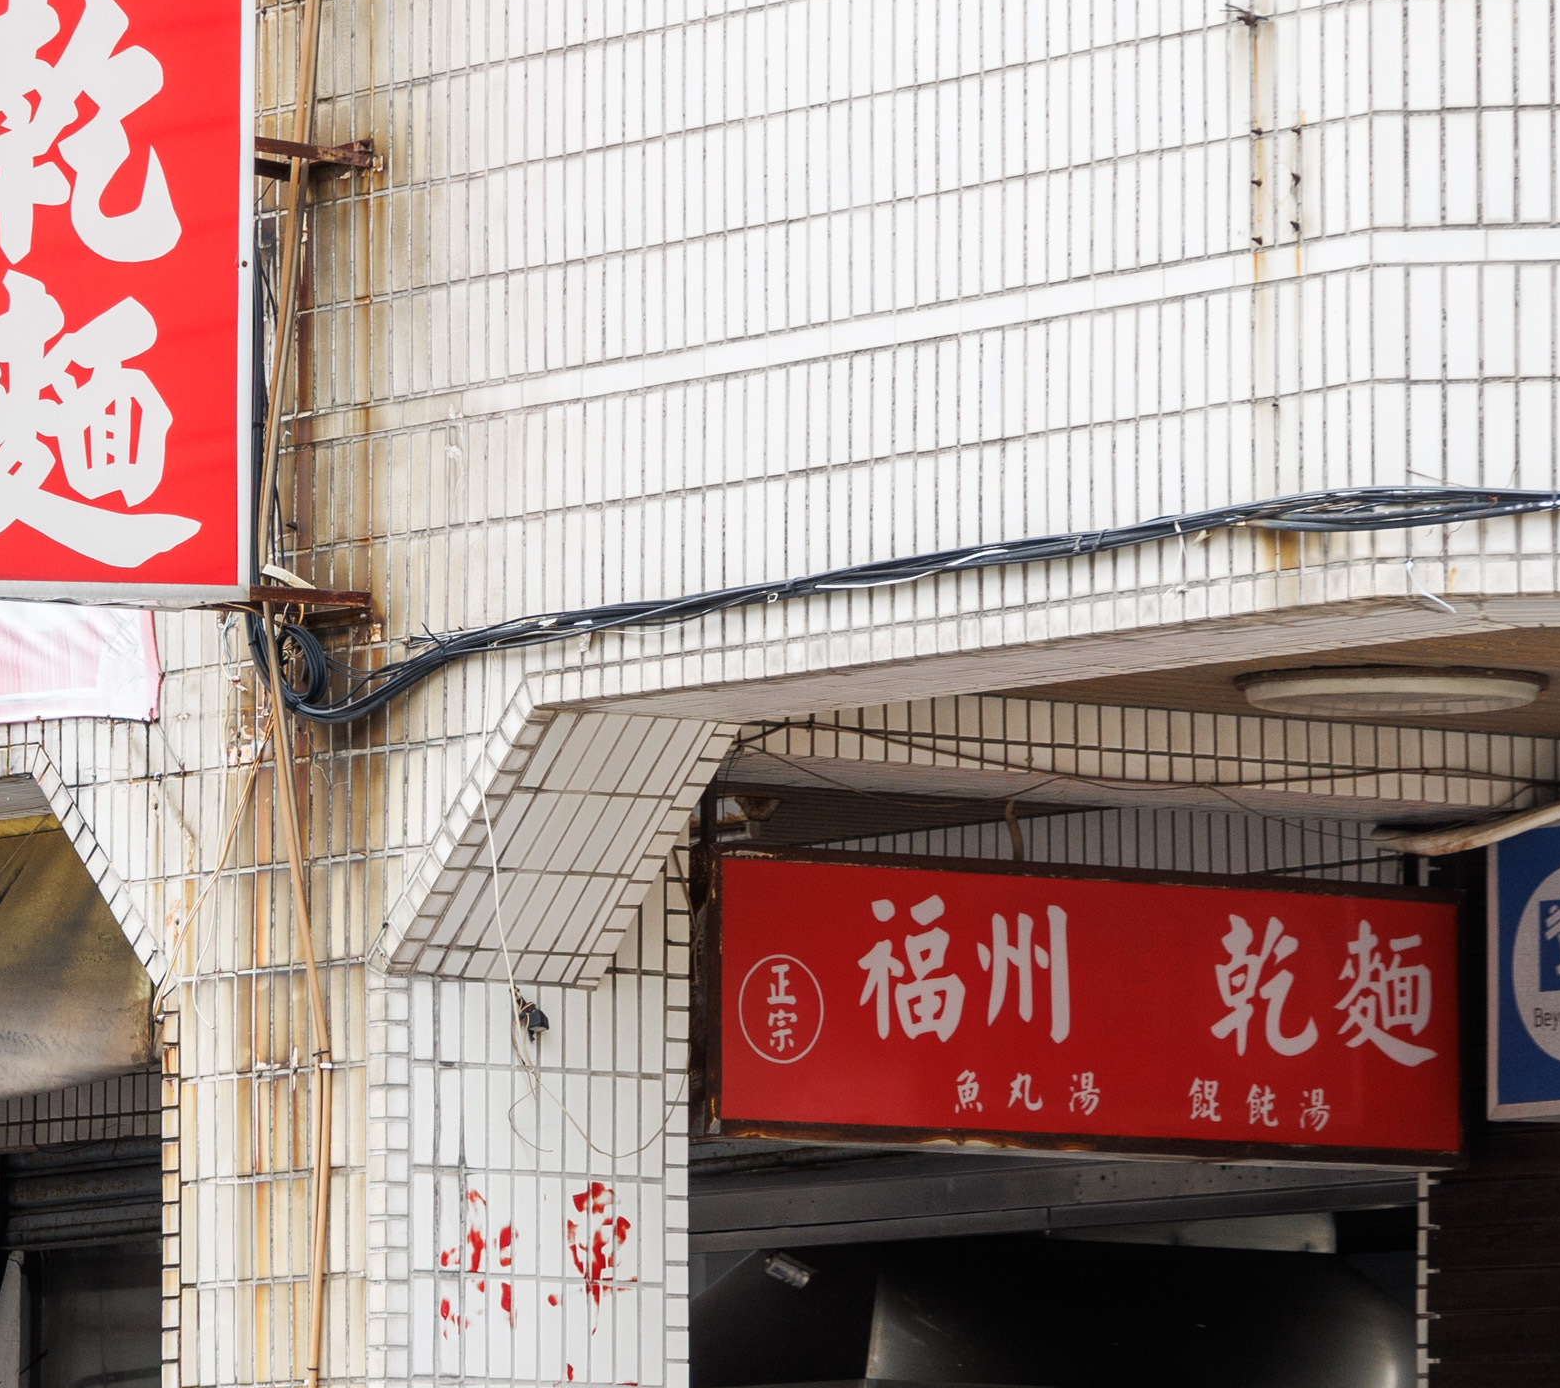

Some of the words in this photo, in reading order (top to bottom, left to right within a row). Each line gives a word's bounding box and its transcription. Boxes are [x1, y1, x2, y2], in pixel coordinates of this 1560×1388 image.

[767, 964, 797, 1052] 正宗
[858, 895, 1070, 1043] 福州
[1211, 915, 1438, 1066] 乾麵
[955, 1069, 1100, 1115] 魚丸湯
[1188, 1076, 1331, 1132] 餛飩湯
